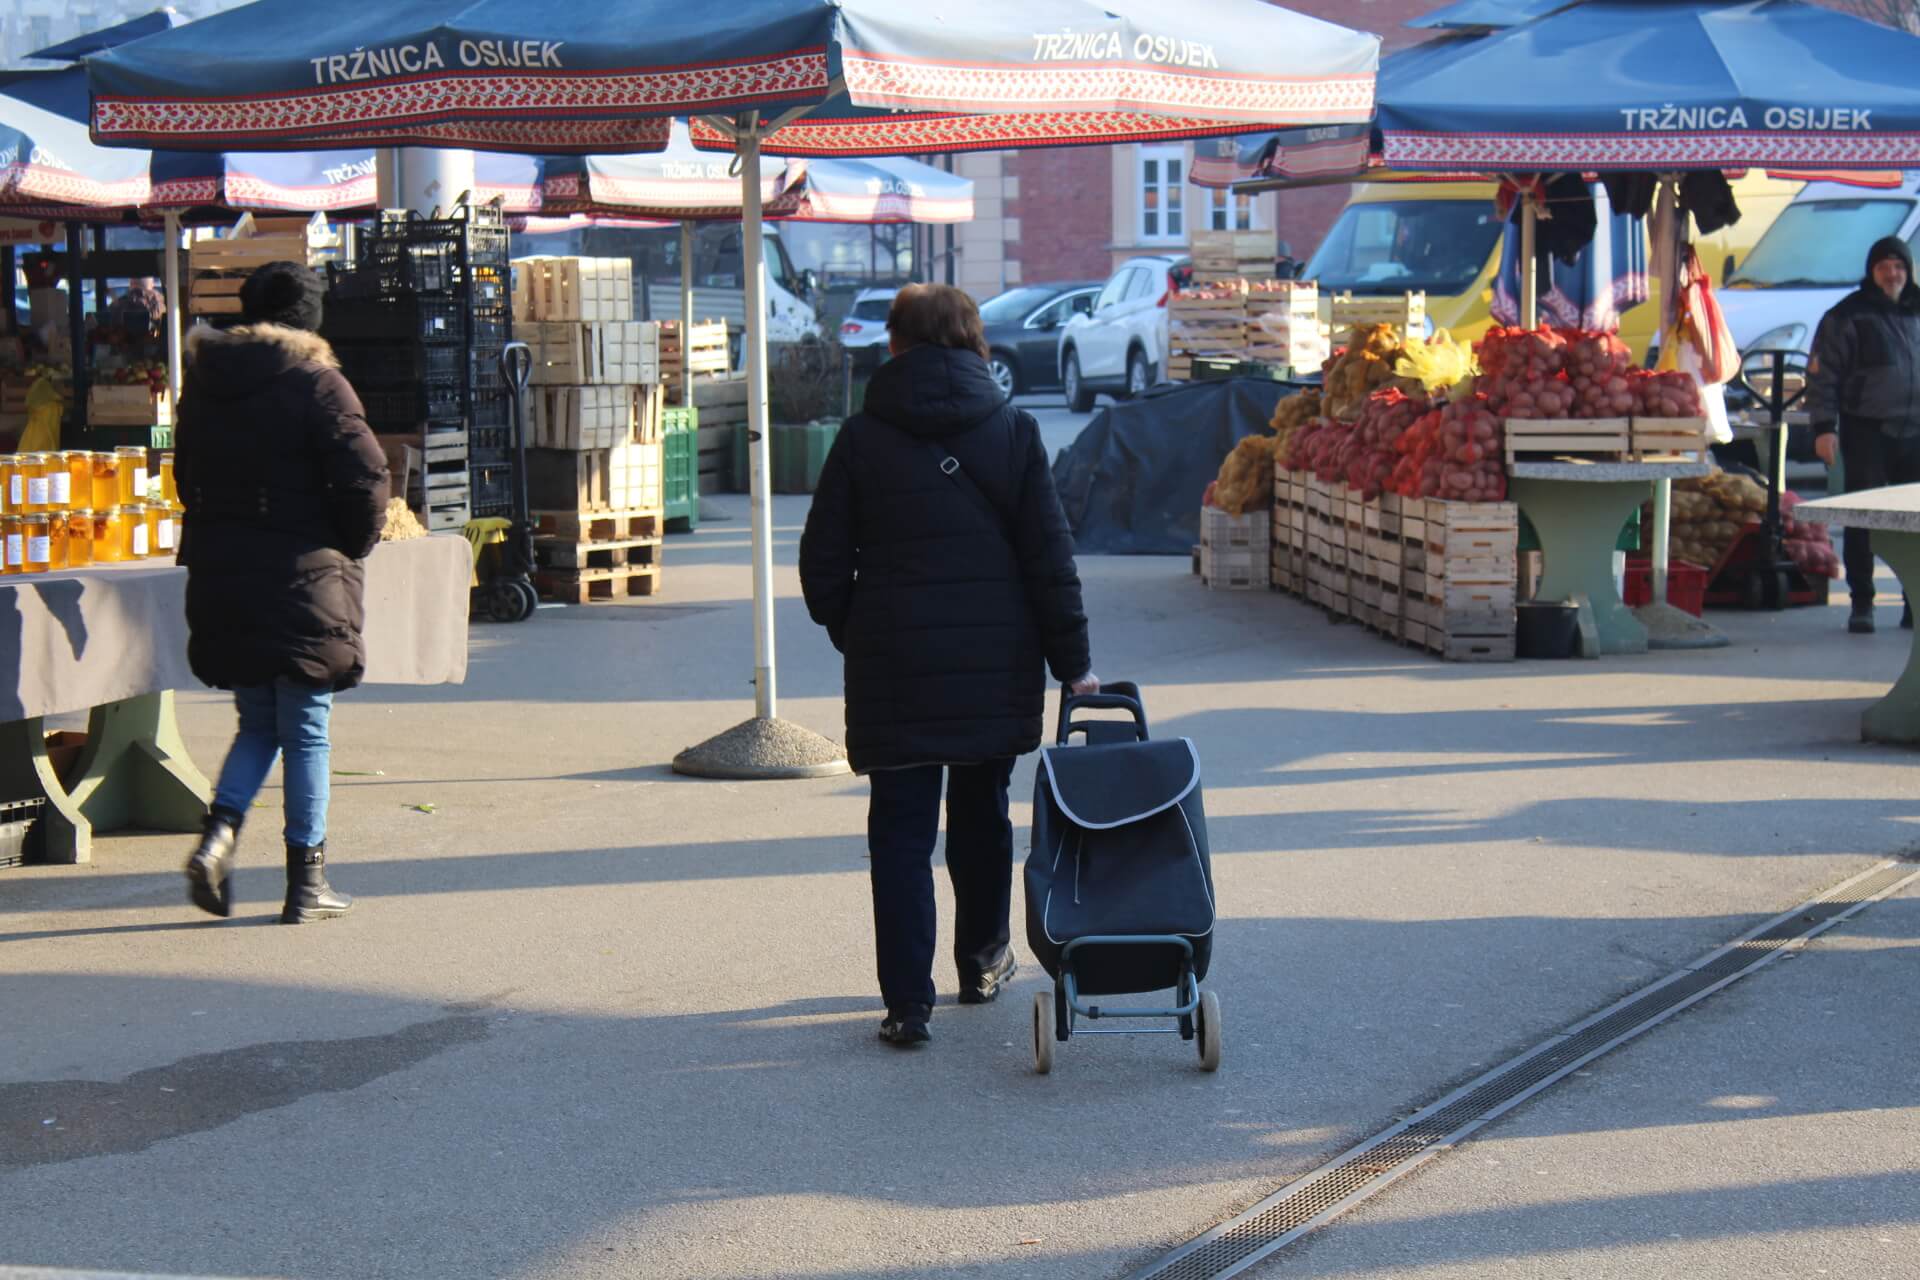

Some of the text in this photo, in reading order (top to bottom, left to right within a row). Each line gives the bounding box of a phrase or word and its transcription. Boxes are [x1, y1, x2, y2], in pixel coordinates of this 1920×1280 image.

[310, 40, 564, 84] TRŽNICA OSIJEK
[1033, 27, 1219, 69] TRŽNICA OSIJEK
[1620, 103, 1872, 130] TRŽNICA OSIJEK
